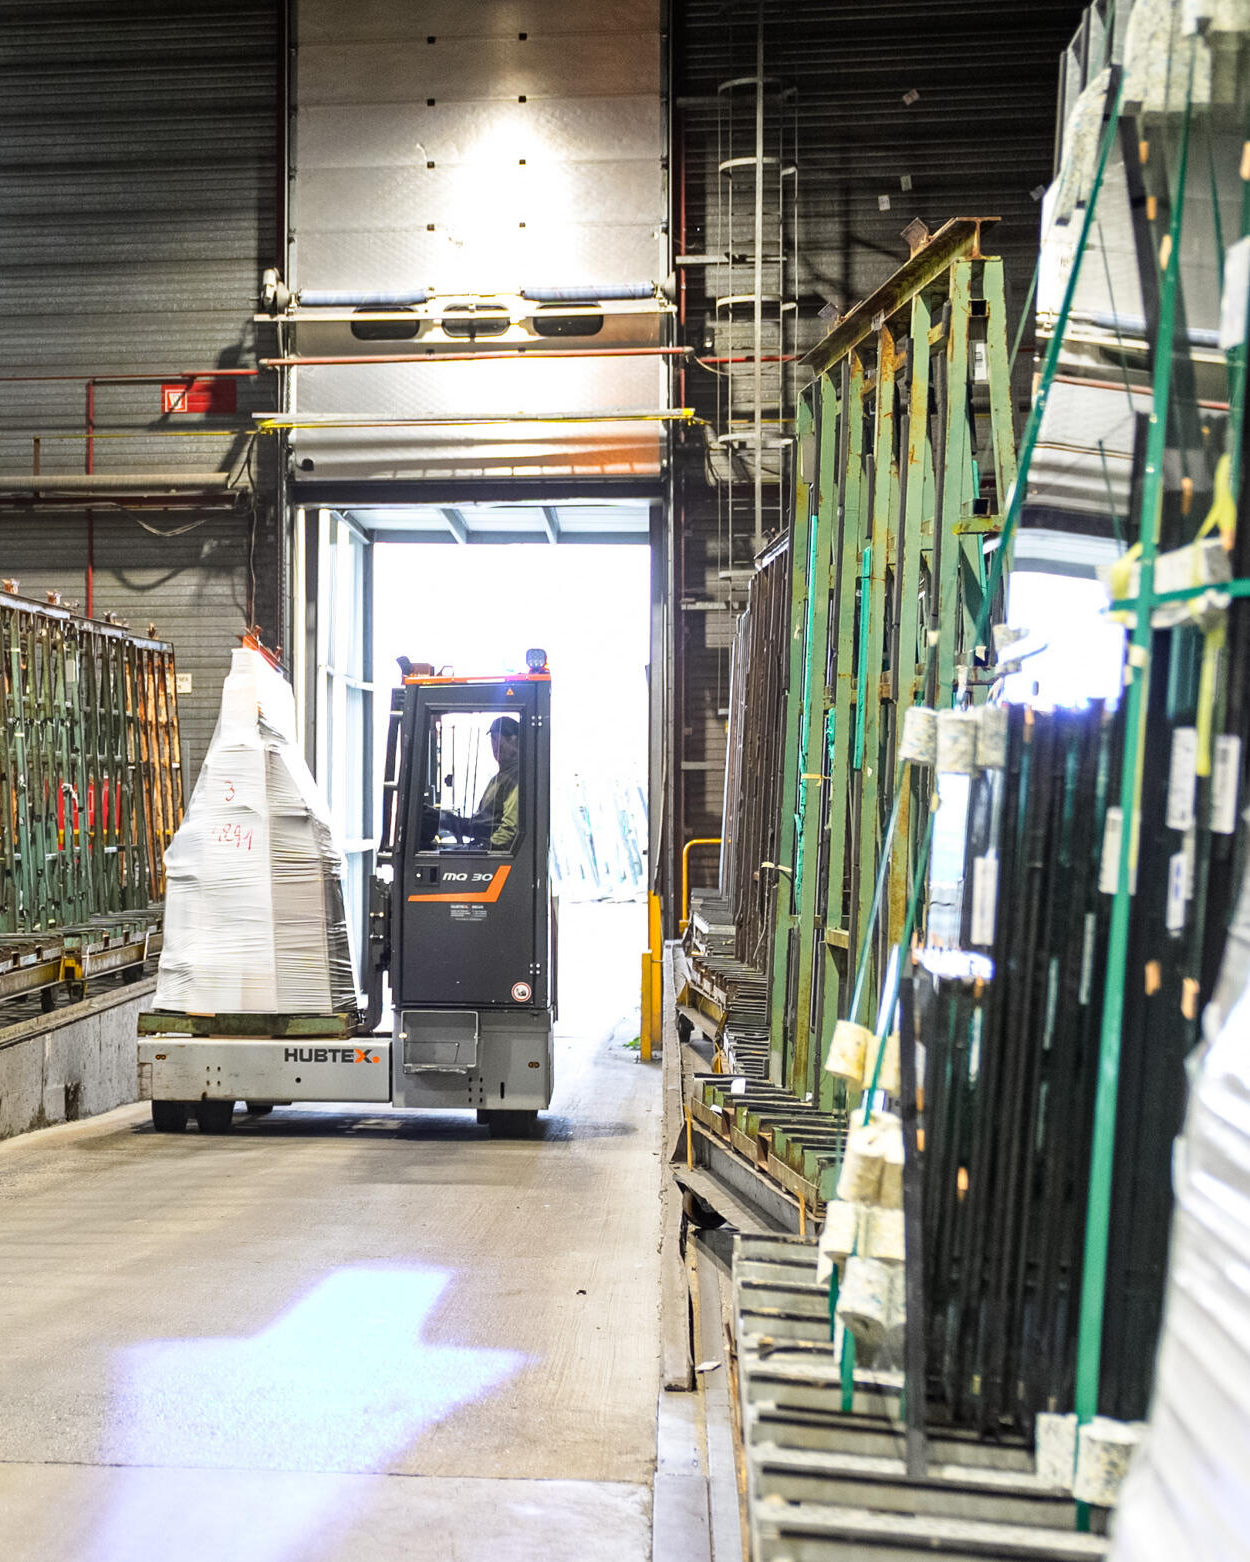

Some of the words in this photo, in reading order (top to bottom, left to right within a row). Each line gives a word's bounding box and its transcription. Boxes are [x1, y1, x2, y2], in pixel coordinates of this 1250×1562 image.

[223, 780, 235, 801] 3
[471, 873, 494, 882] 30
[284, 1048, 373, 1064] HUBTEX
